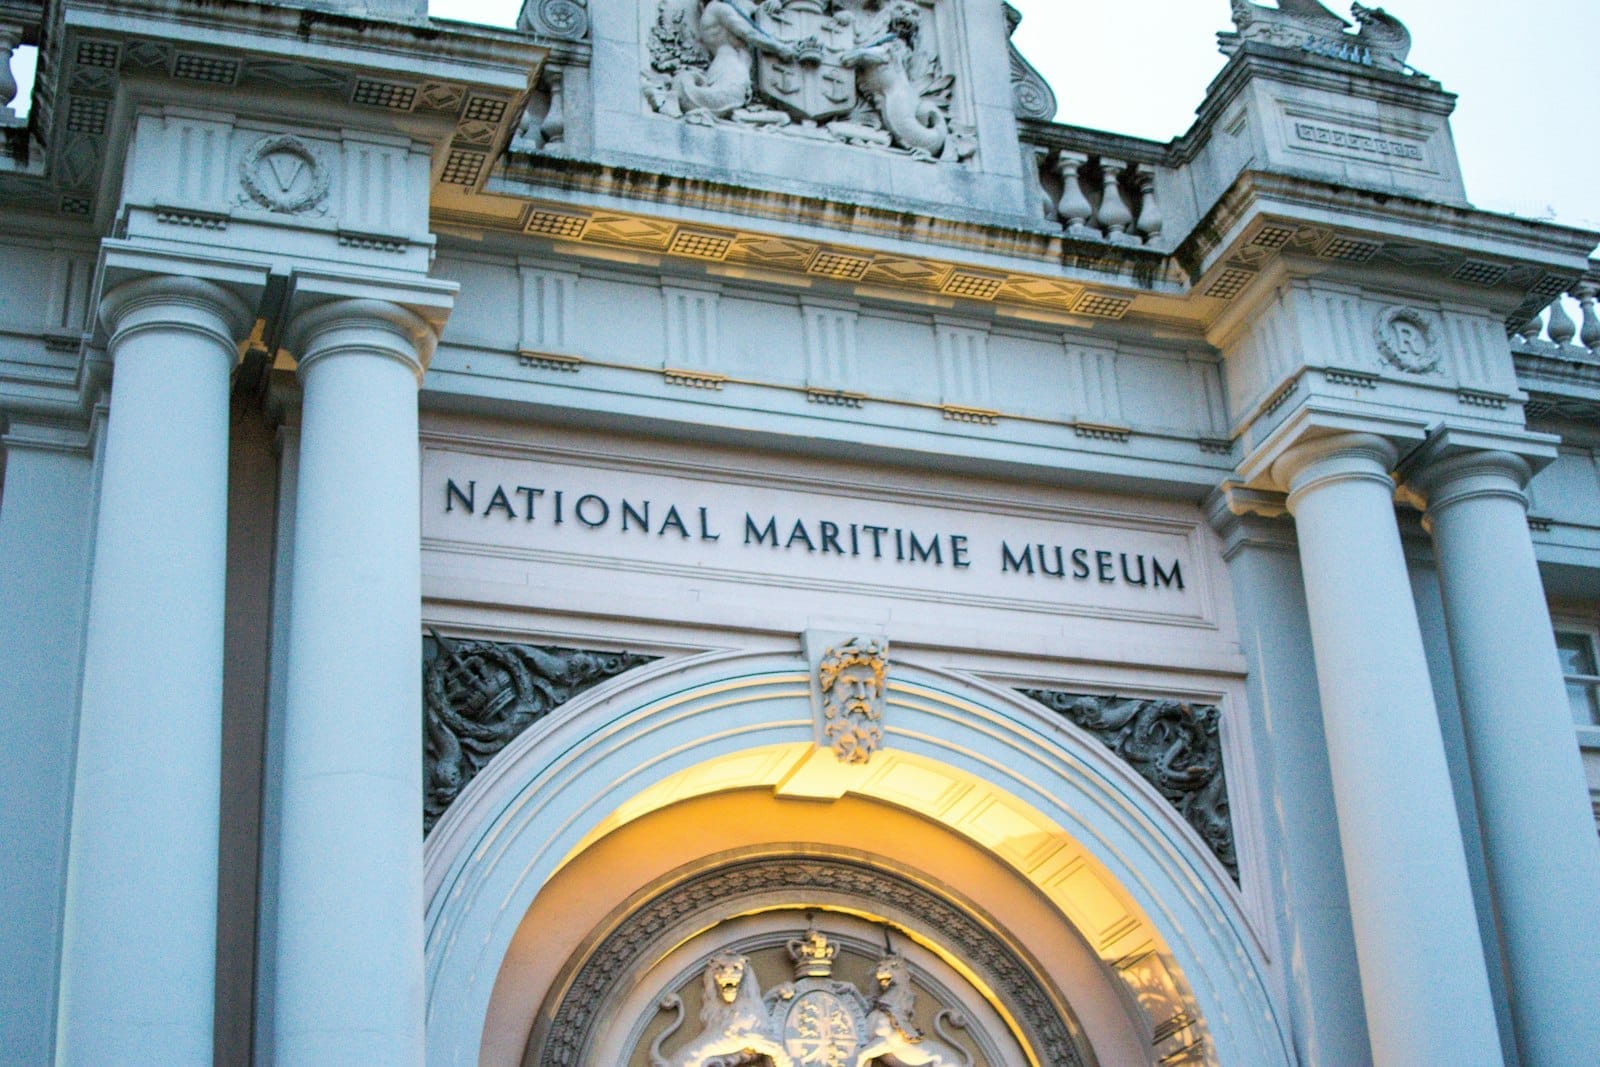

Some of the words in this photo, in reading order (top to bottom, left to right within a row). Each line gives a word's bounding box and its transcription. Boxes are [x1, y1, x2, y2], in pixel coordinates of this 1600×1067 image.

[445, 477, 721, 541] NATIONAL
[743, 511, 971, 569] MARITIME
[1001, 540, 1186, 590] MUSEUM
